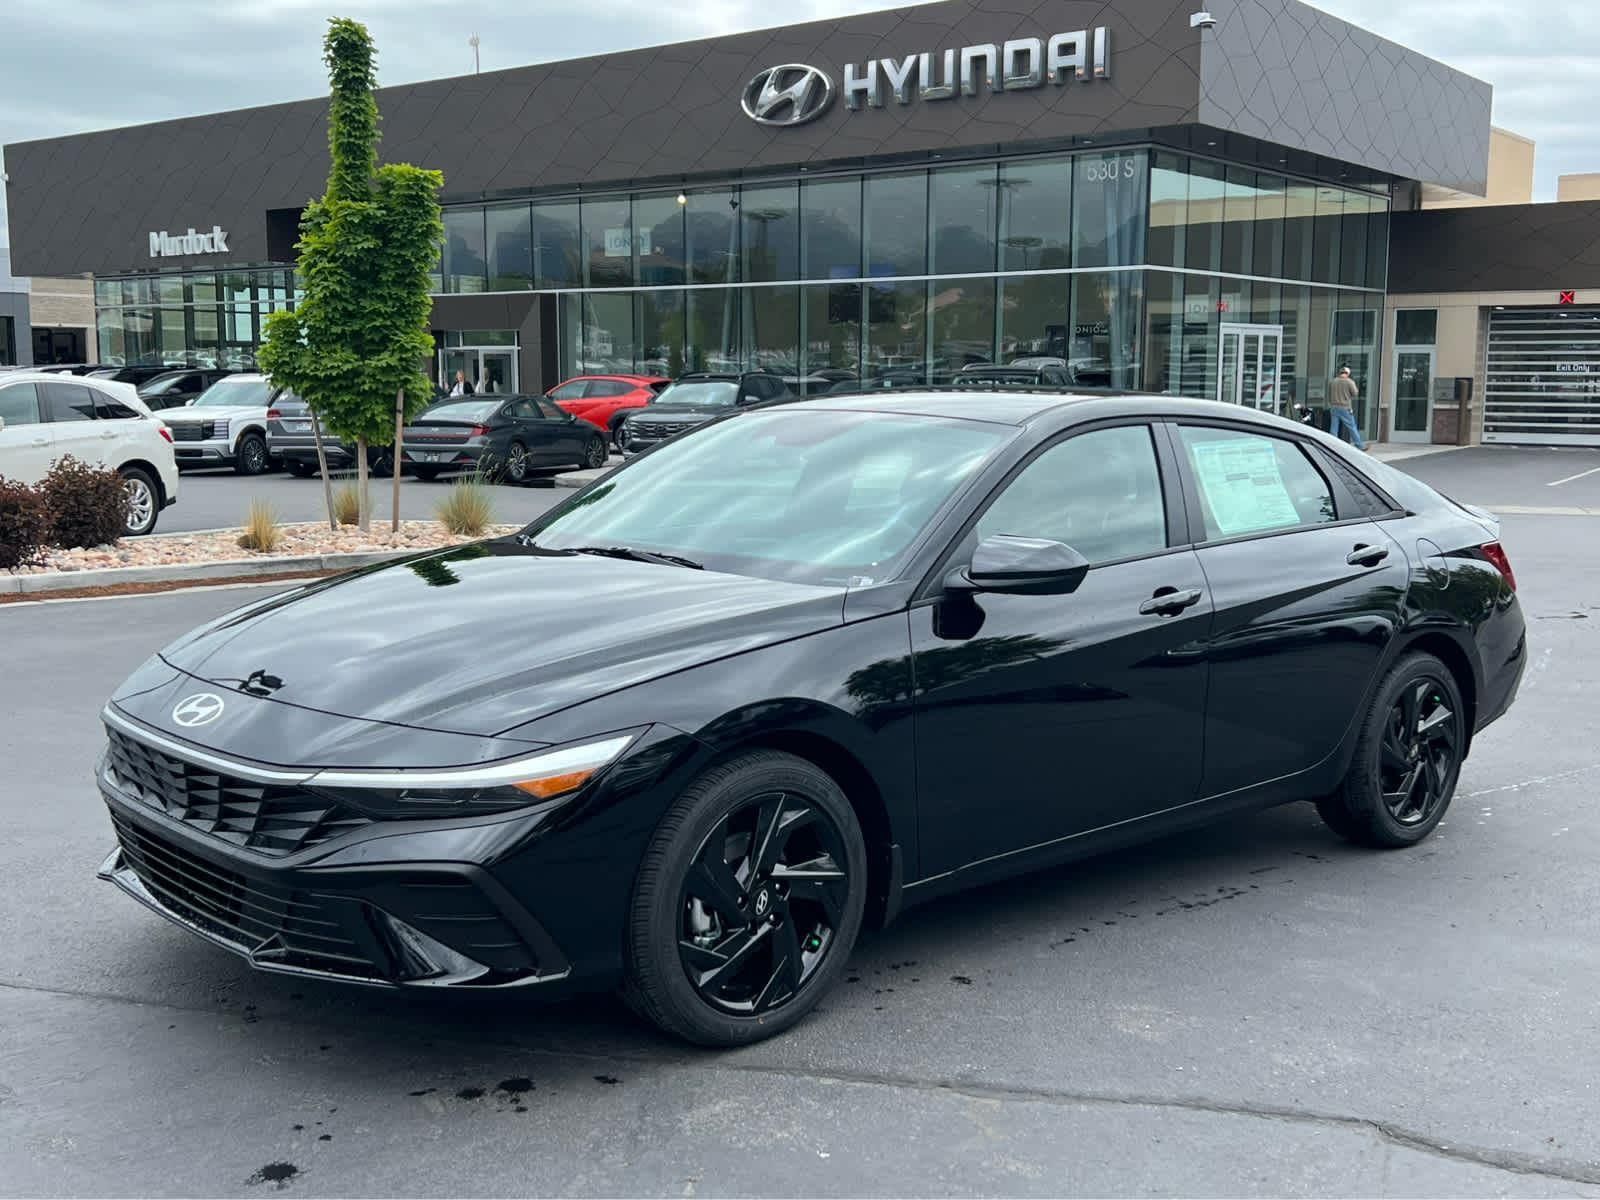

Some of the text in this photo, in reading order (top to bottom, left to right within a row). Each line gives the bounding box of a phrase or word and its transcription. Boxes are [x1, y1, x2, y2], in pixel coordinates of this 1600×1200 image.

[844, 26, 1111, 110] HYUNDAI
[1124, 159, 1134, 178] S
[149, 225, 230, 257] Murdock
[1556, 361, 1571, 371] Exit
